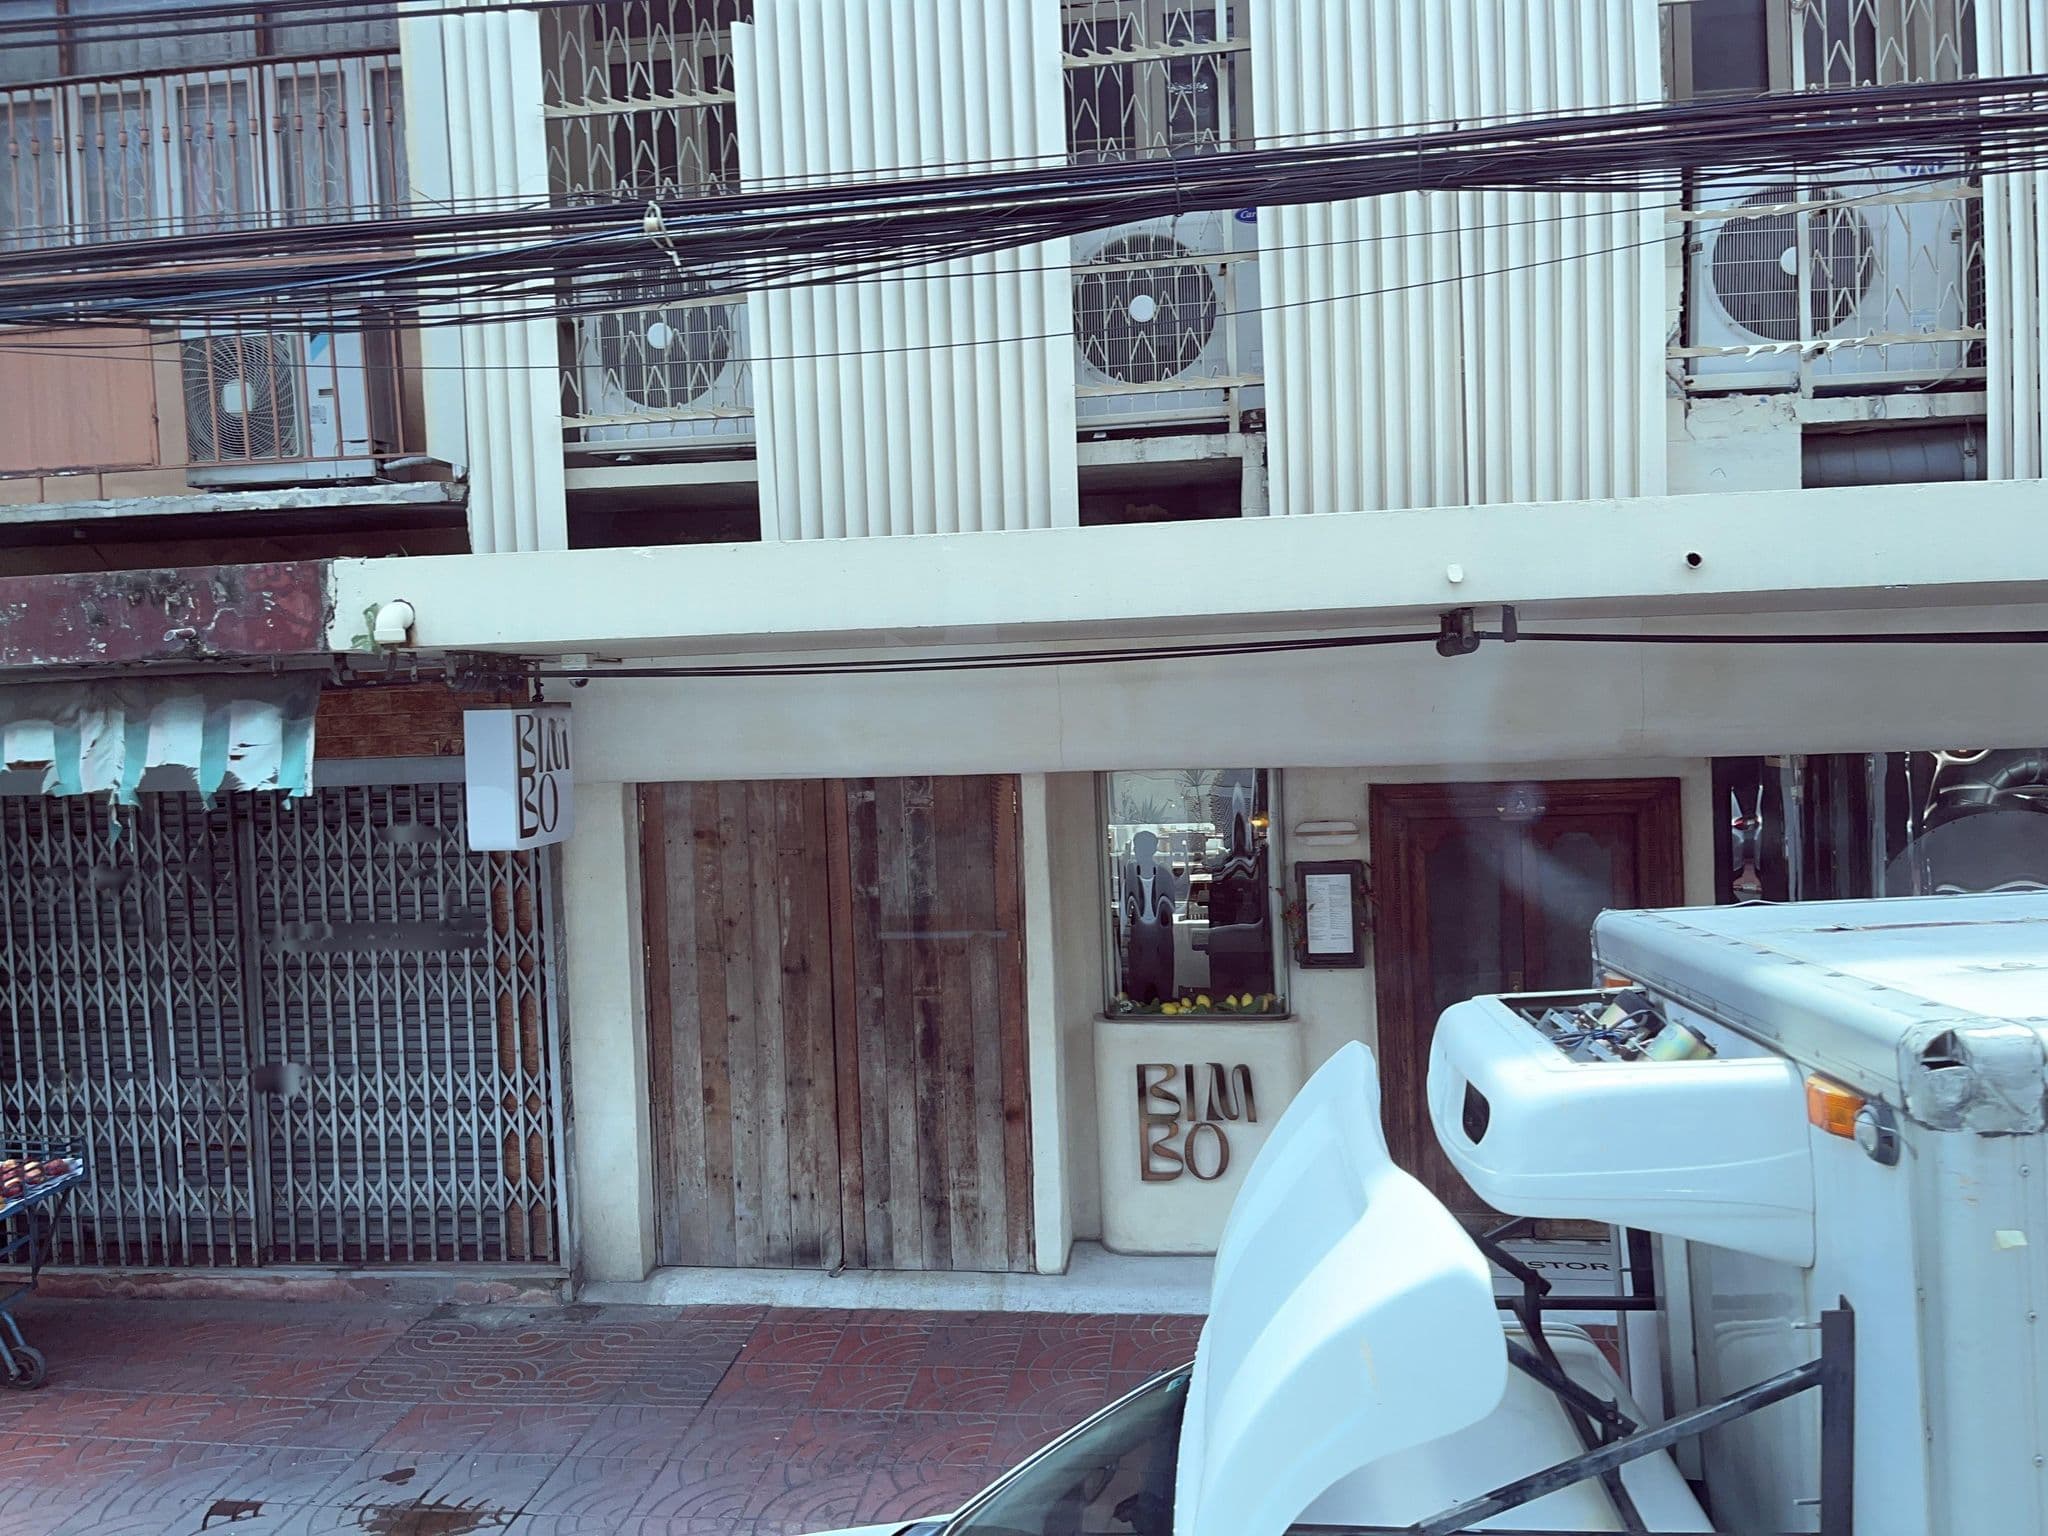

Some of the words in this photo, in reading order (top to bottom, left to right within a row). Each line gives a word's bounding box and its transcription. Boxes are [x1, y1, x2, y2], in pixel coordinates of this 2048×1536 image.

[516, 714, 570, 775] BIM
[518, 773, 559, 839] BO
[1136, 1062, 1257, 1122] BIM
[1140, 1119, 1230, 1181] BO
[1522, 1261, 1611, 1271] STOR
